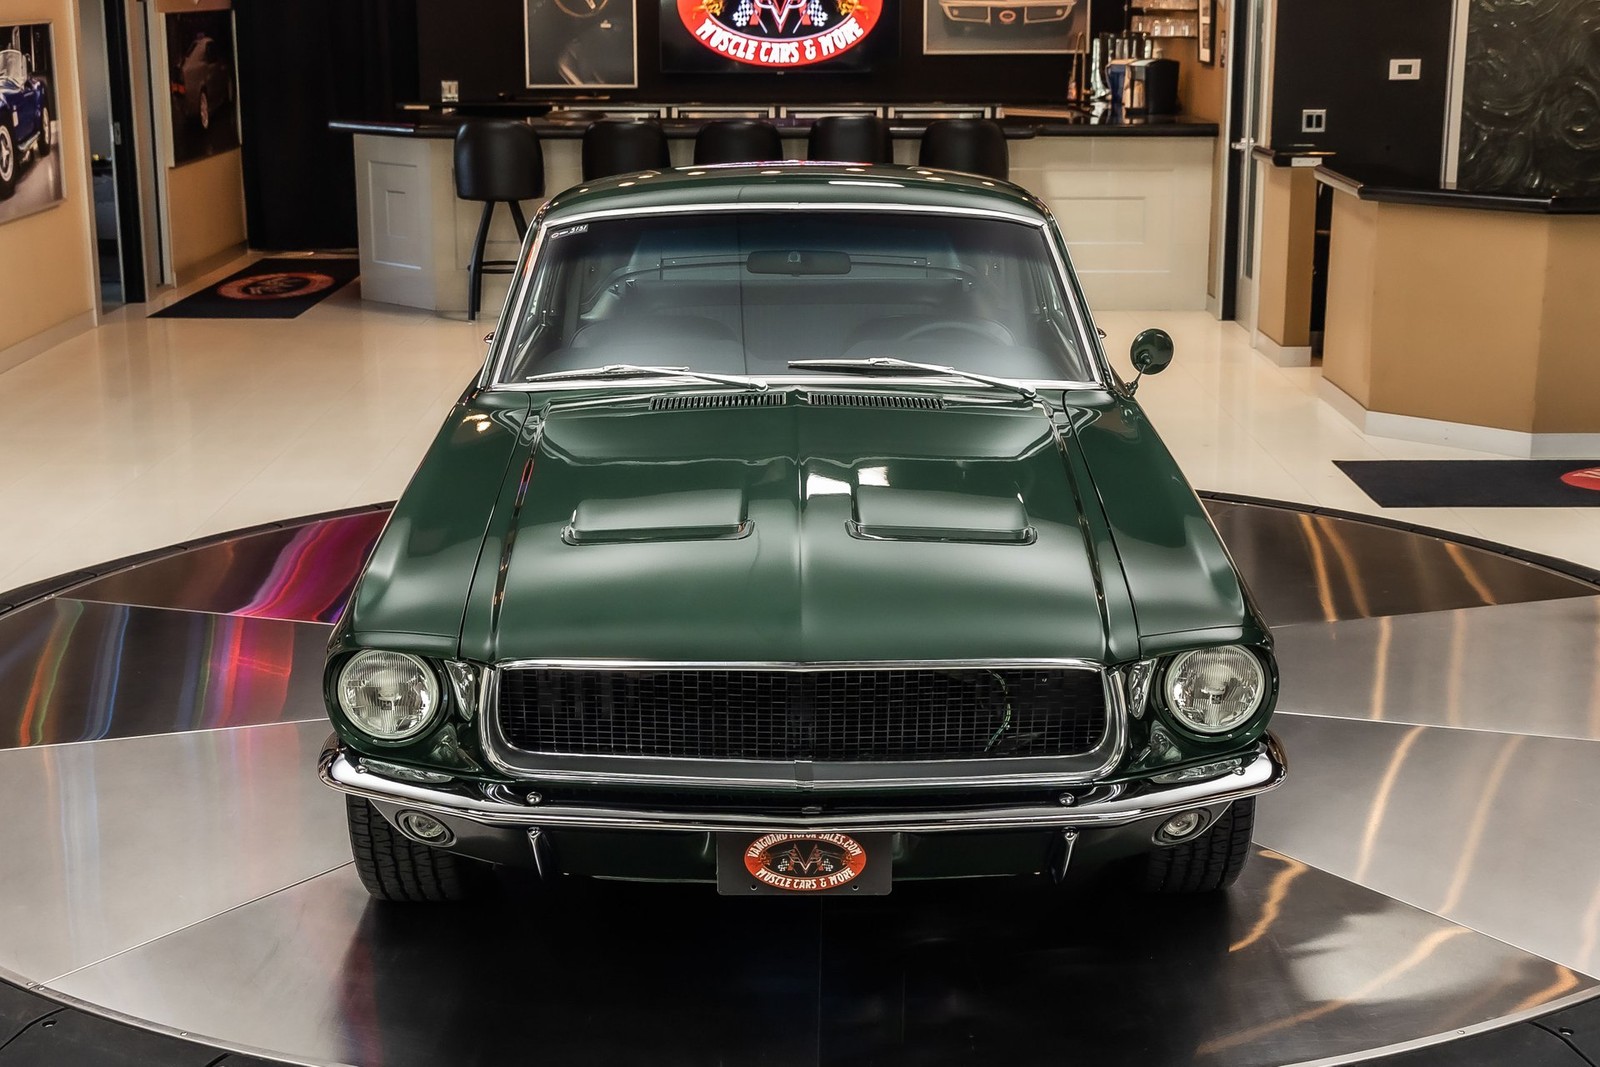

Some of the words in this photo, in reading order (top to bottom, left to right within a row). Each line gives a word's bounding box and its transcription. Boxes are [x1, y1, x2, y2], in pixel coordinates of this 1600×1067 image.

[695, 18, 759, 60] MUSCLE
[759, 41, 800, 63] CARS
[803, 40, 816, 61] &
[818, 17, 864, 57] MORE
[747, 833, 788, 858] VANGUARD
[755, 867, 792, 888] MUSCLE
[793, 879, 817, 889] CARS
[821, 878, 827, 888] &
[830, 867, 855, 886] MORE
